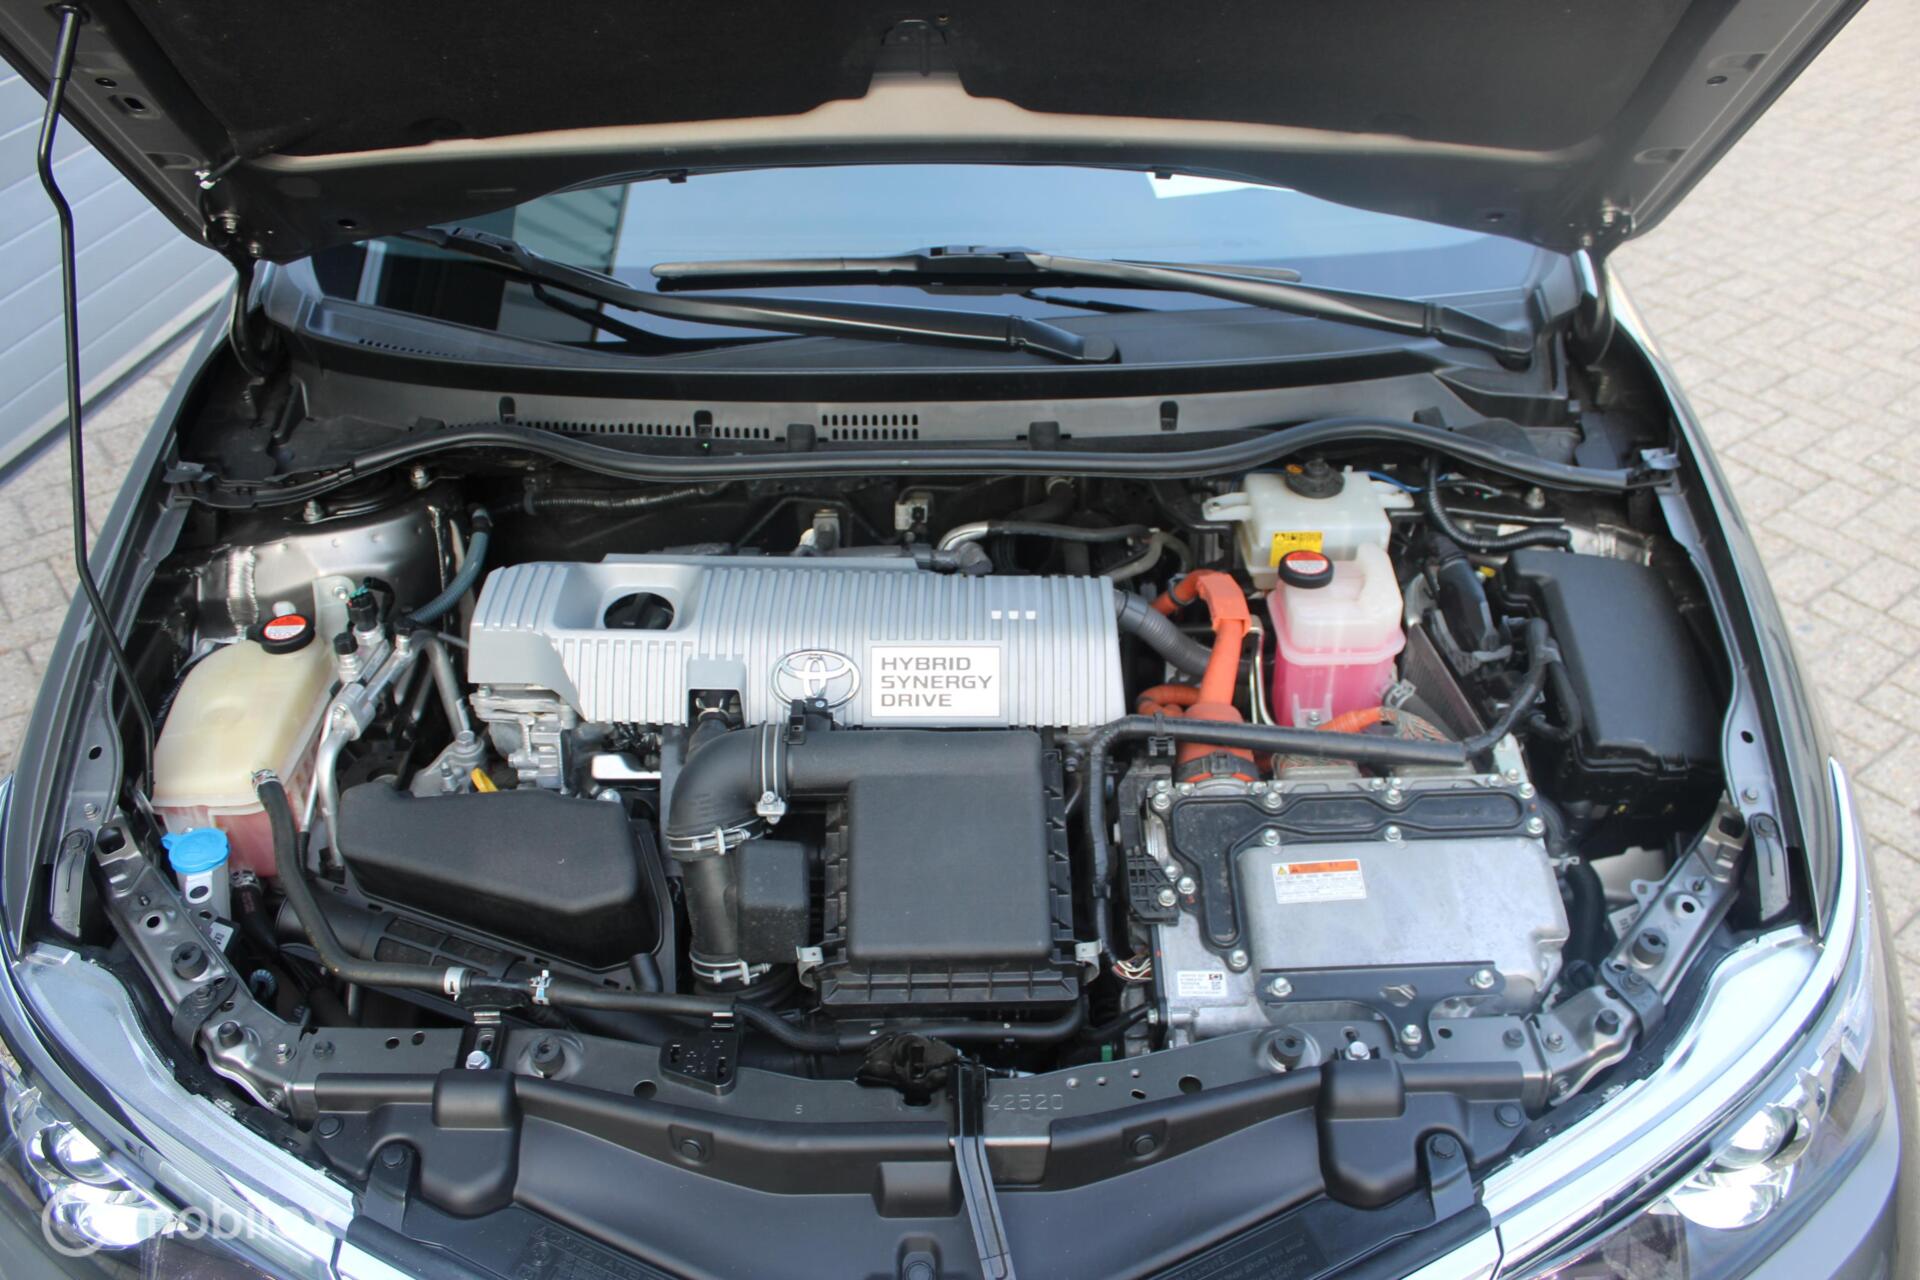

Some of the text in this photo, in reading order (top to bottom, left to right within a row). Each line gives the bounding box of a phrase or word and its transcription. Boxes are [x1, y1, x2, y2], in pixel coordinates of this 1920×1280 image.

[881, 657, 972, 671] HYBRID
[881, 675, 993, 689] SYNERGY
[881, 693, 952, 707] DRIVE
